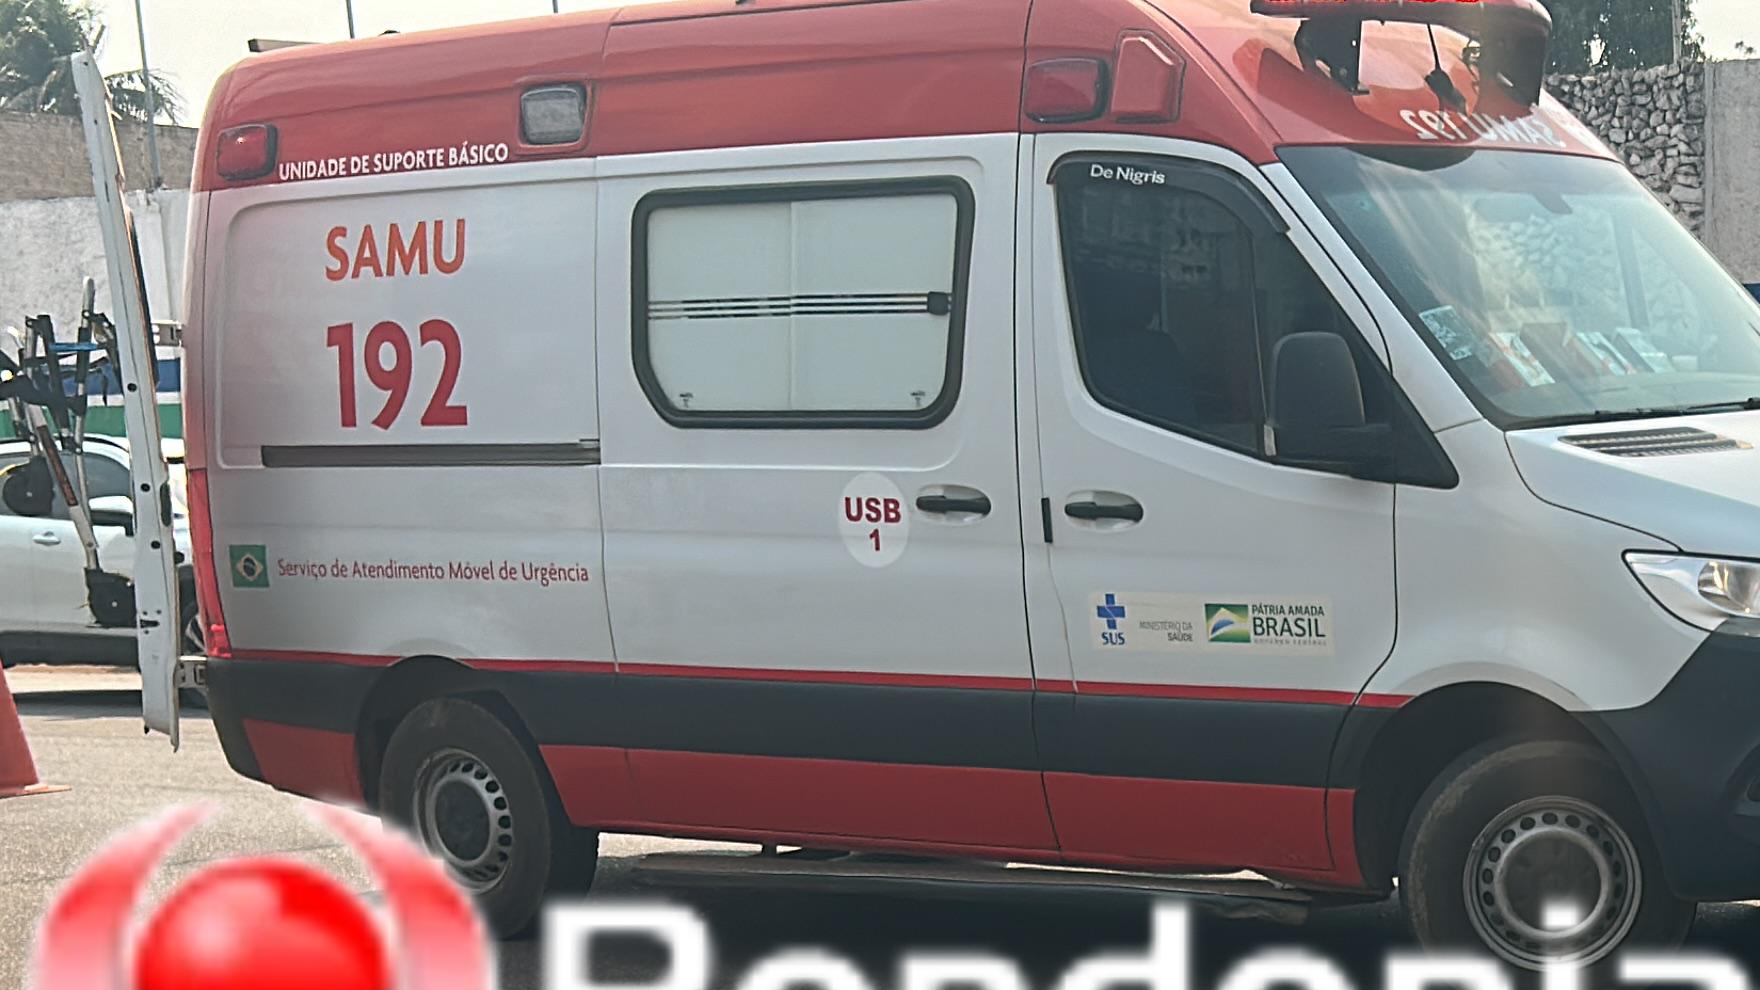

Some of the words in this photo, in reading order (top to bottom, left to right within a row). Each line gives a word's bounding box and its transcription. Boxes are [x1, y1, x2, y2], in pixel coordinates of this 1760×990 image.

[279, 156, 347, 180] UNIDADE
[350, 154, 369, 174] DE
[374, 147, 445, 172] SUPORTE
[449, 141, 508, 165] BÁSICO
[1090, 163, 1114, 179] De
[1116, 166, 1166, 185] Nigris
[325, 218, 466, 282] SAMU
[326, 318, 468, 430] 192
[845, 496, 902, 523] USB
[869, 528, 881, 552] 1
[277, 558, 327, 580] Serviço
[331, 558, 348, 578] de
[352, 560, 445, 579] Atendimento
[449, 560, 495, 581] Móvel
[499, 561, 518, 581] de
[521, 562, 590, 587] Urgência
[1251, 602, 1286, 615] PÁTRIA
[1288, 605, 1326, 616] AMADA
[1101, 631, 1126, 646] SUS
[1253, 616, 1327, 637] BRASIL
